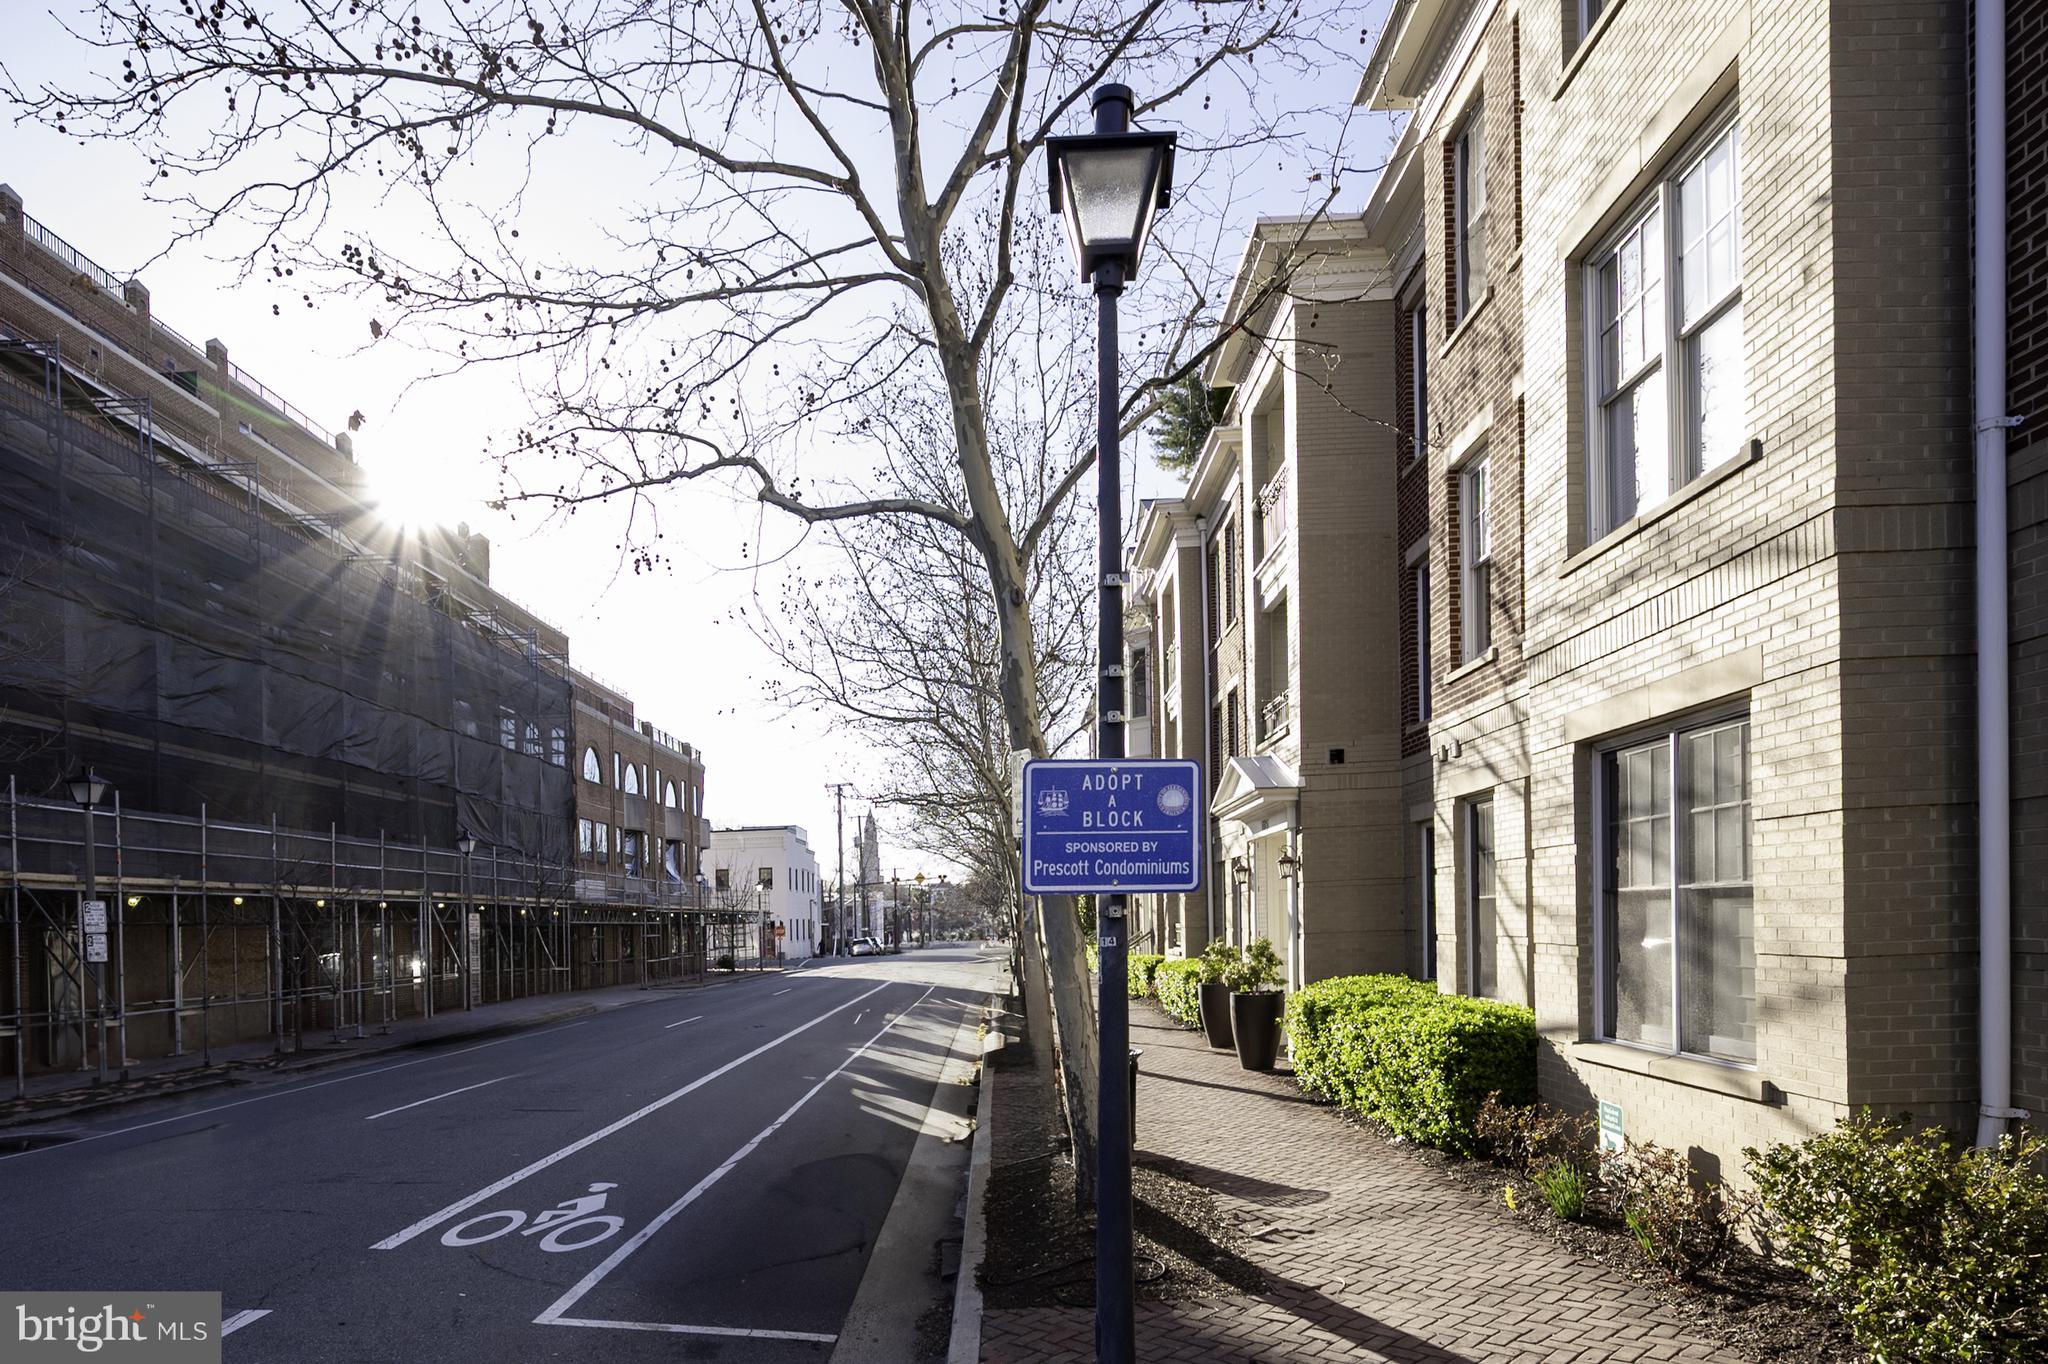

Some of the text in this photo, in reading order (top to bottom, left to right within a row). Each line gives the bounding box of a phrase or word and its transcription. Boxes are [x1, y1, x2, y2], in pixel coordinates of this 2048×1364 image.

[1083, 775, 1142, 790] ADOPT
[1109, 795, 1116, 807] A
[1084, 811, 1142, 827] BLOCK
[1066, 842, 1157, 852] SPONSORED BY
[1035, 859, 1189, 875] Prescott Condominiums
